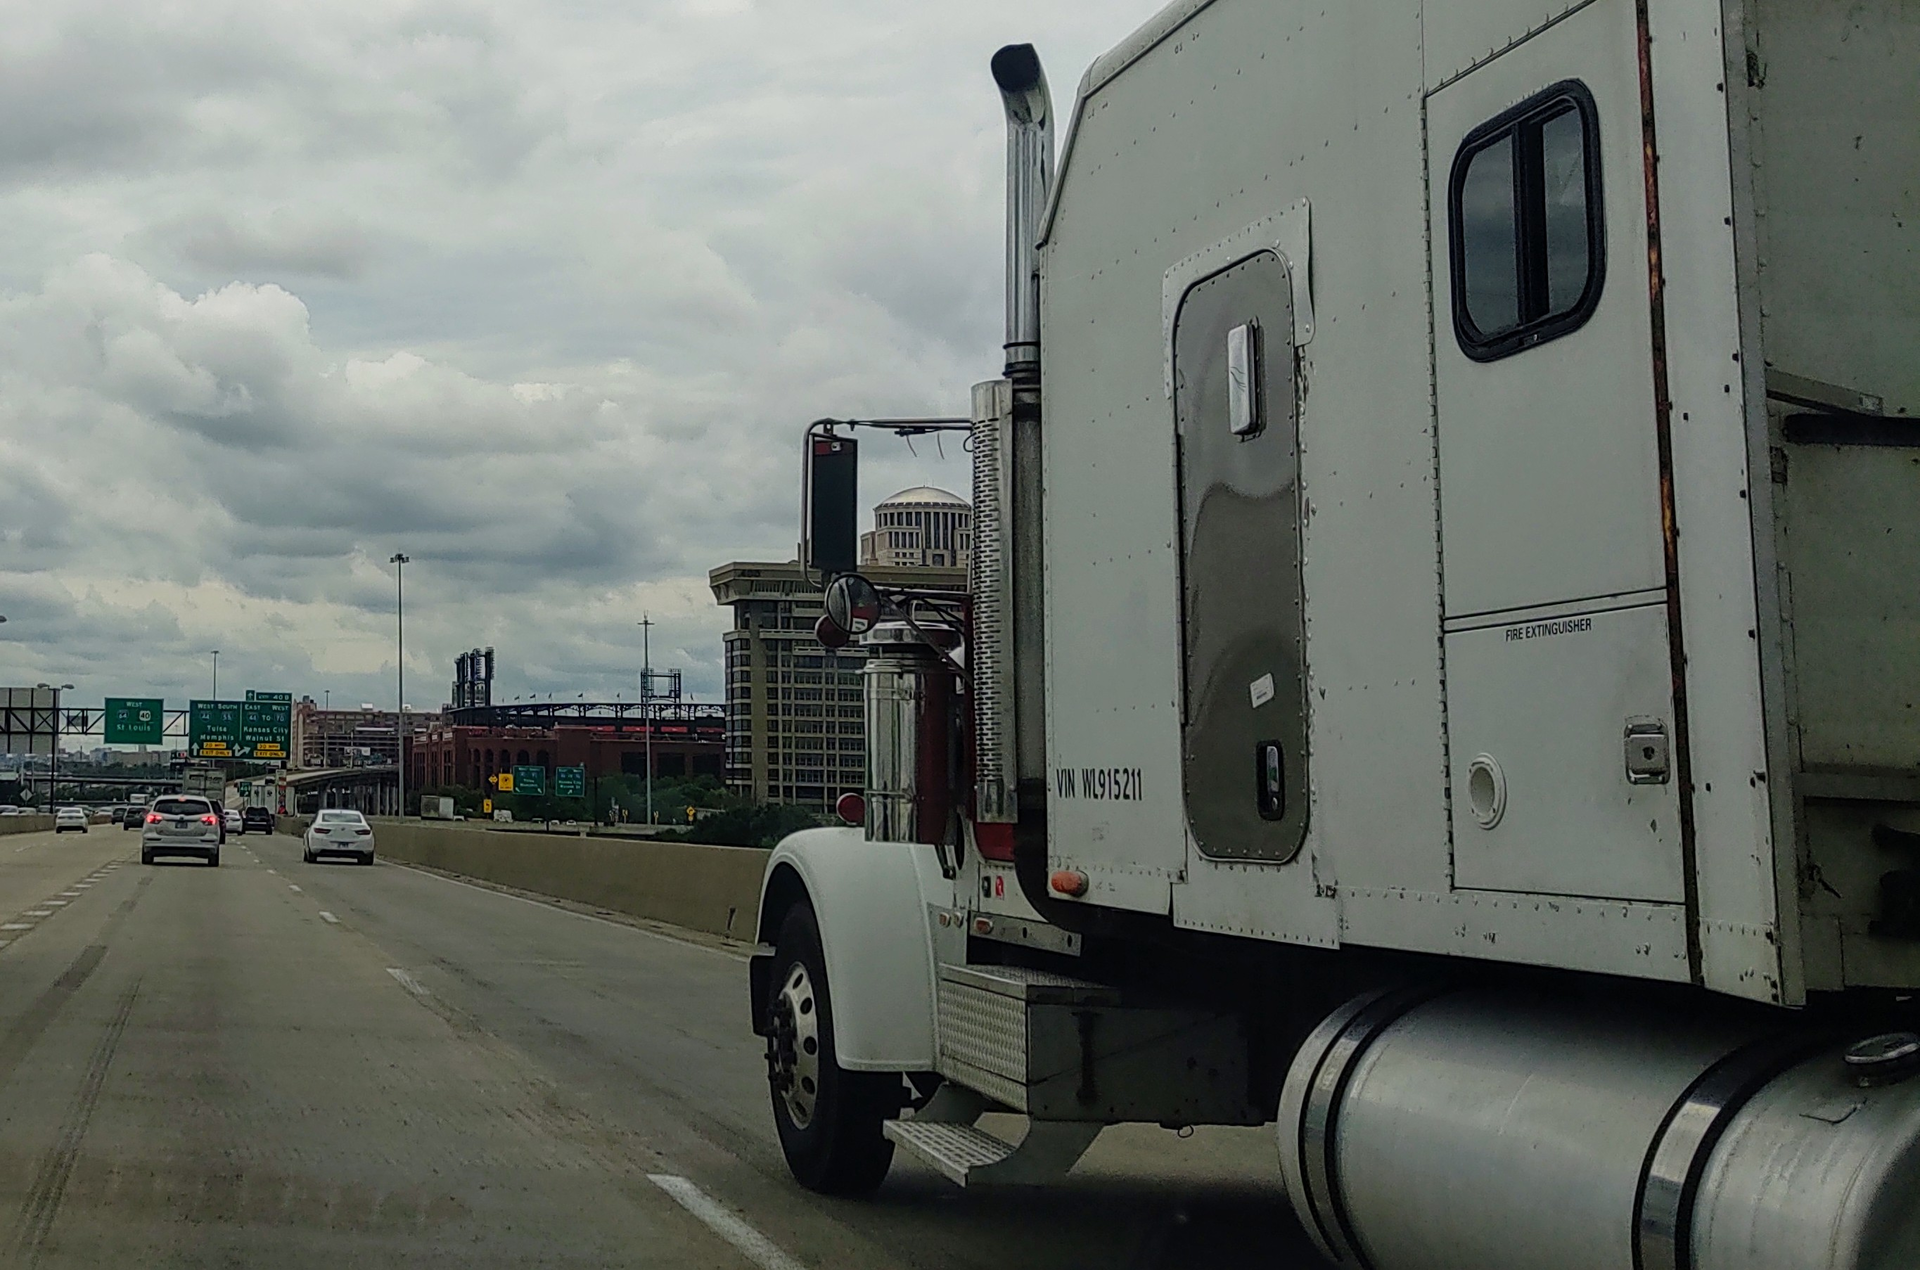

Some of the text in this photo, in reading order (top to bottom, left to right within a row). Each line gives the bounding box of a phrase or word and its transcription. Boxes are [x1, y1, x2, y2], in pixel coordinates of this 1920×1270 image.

[1505, 618, 1592, 642] FIRE EXTINGUISHER
[272, 726, 289, 735] City
[1056, 767, 1143, 801] VIN WL915211
